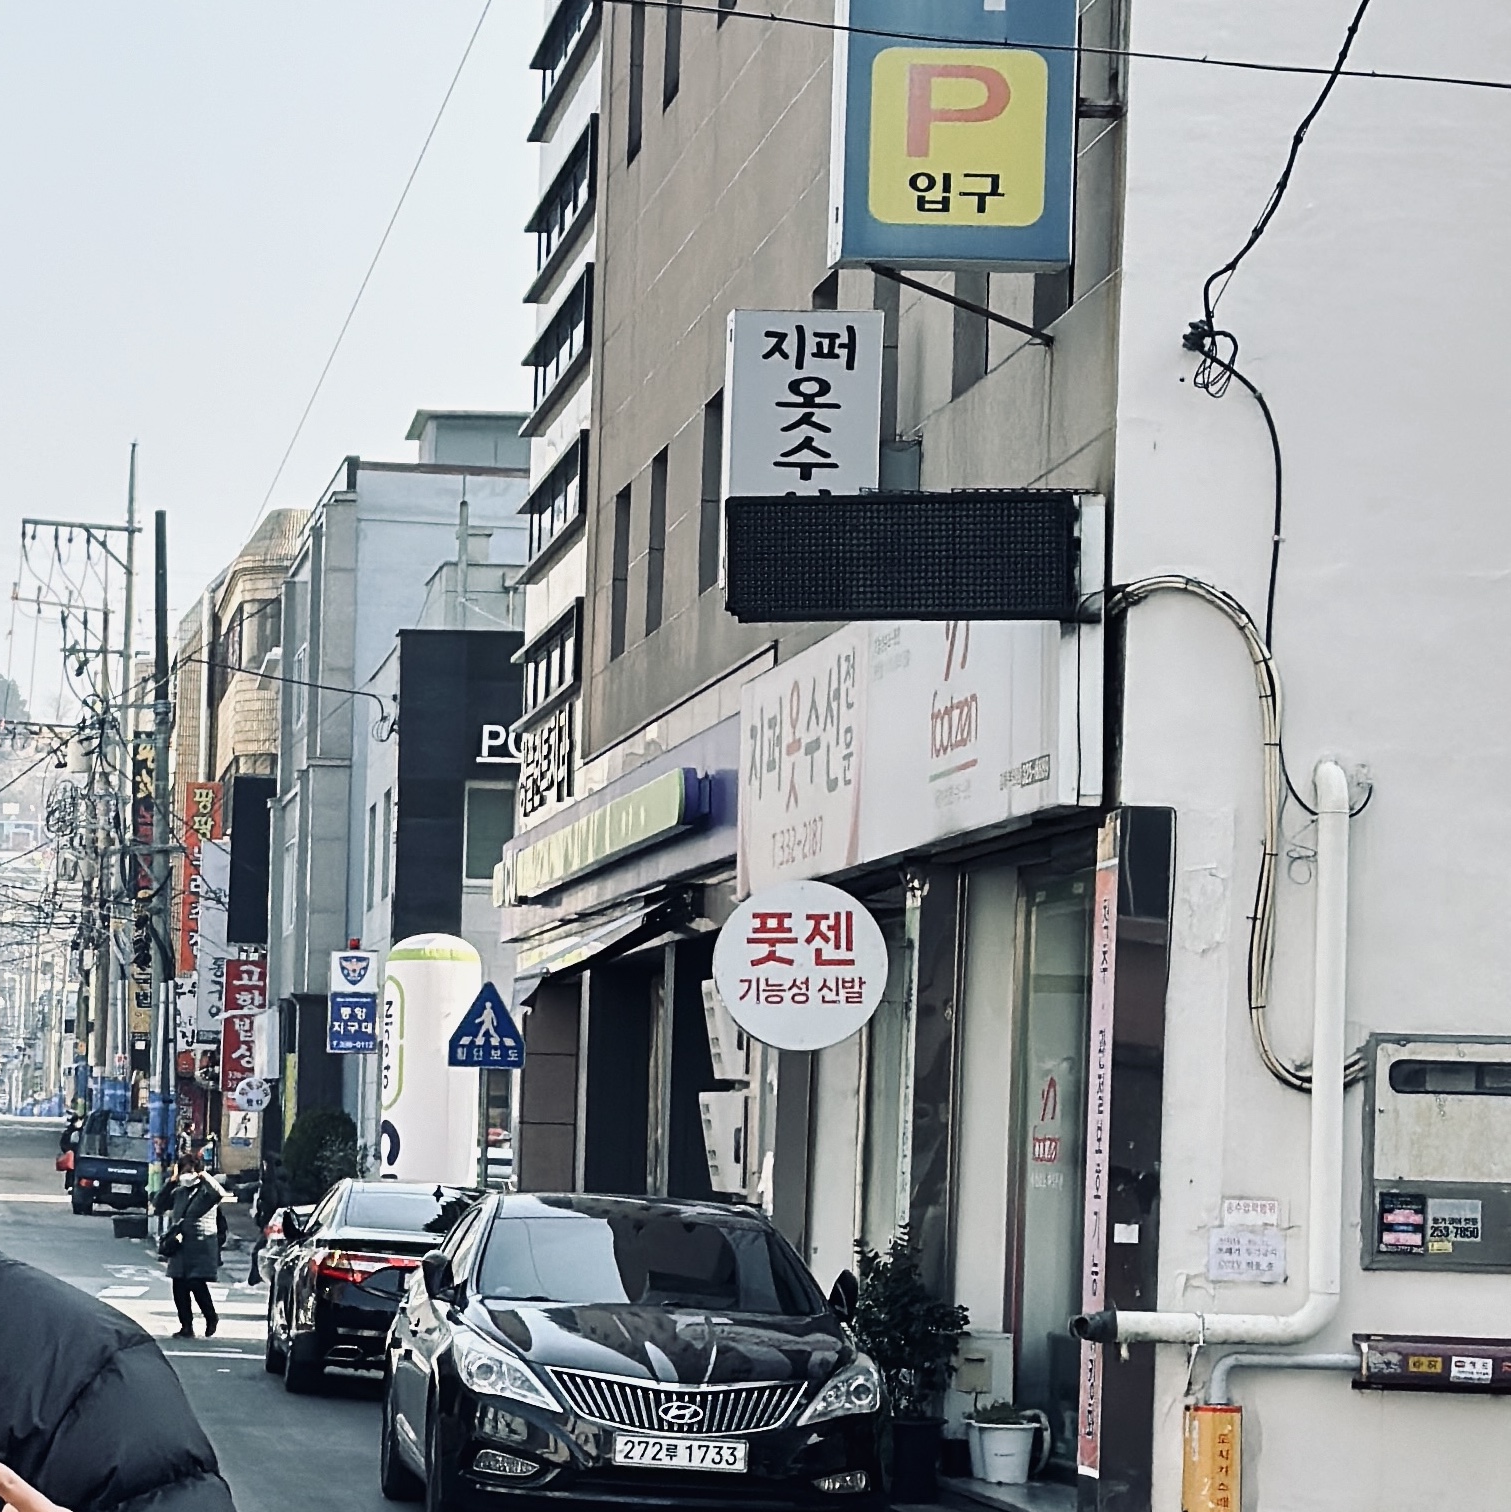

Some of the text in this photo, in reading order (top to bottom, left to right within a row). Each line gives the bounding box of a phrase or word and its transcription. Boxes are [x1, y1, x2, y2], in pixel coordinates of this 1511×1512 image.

[906, 63, 1011, 158] P
[908, 172, 1005, 213] 입구
[762, 324, 856, 370] 지퍼
[773, 376, 841, 496] 옷수
[747, 911, 855, 966] 풋젠
[739, 976, 866, 1004] 기능성 신발
[332, 1021, 373, 1035] 지구대
[457, 1045, 519, 1061] 횡단보도
[623, 1439, 738, 1466] 272루 1733
